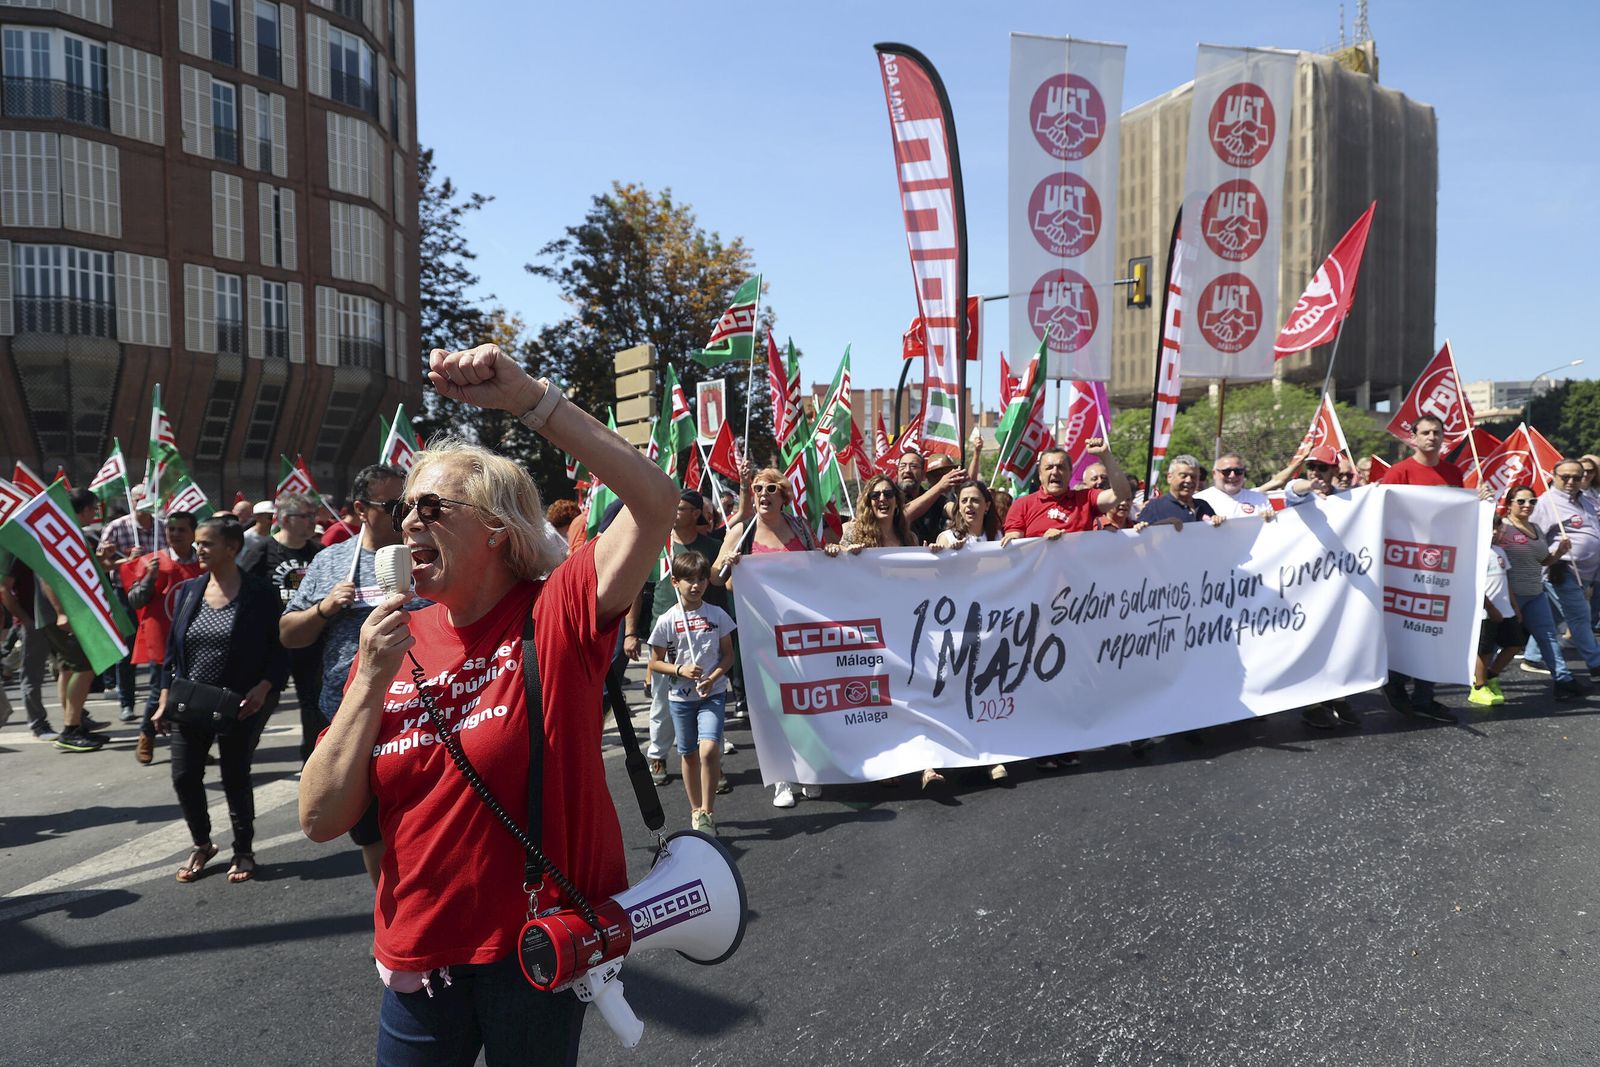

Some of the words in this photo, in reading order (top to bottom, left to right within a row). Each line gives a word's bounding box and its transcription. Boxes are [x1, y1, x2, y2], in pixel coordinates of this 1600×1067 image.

[1046, 86, 1090, 117] UGT
[1224, 95, 1264, 126] UGT
[1044, 184, 1086, 215] UGT
[1217, 192, 1256, 220] UGT
[1043, 281, 1084, 311] UGT
[1212, 285, 1250, 313] UGT
[1051, 582, 1115, 626] Subir
[1200, 569, 1263, 609] bajar
[1279, 546, 1373, 599] precios
[987, 607, 1015, 632] DE
[782, 626, 861, 651] CCOO
[1097, 614, 1182, 670] repartir
[1184, 602, 1306, 652] beneficios
[836, 654, 884, 667] Málaga
[933, 601, 1066, 719] MAYO
[389, 681, 415, 694] En
[791, 684, 841, 711] UGT
[400, 718, 416, 733] y
[461, 695, 481, 715] un
[452, 705, 508, 733] digno
[844, 711, 888, 726] Málaga
[976, 697, 1015, 723] 2023
[652, 890, 702, 919] CCOO
